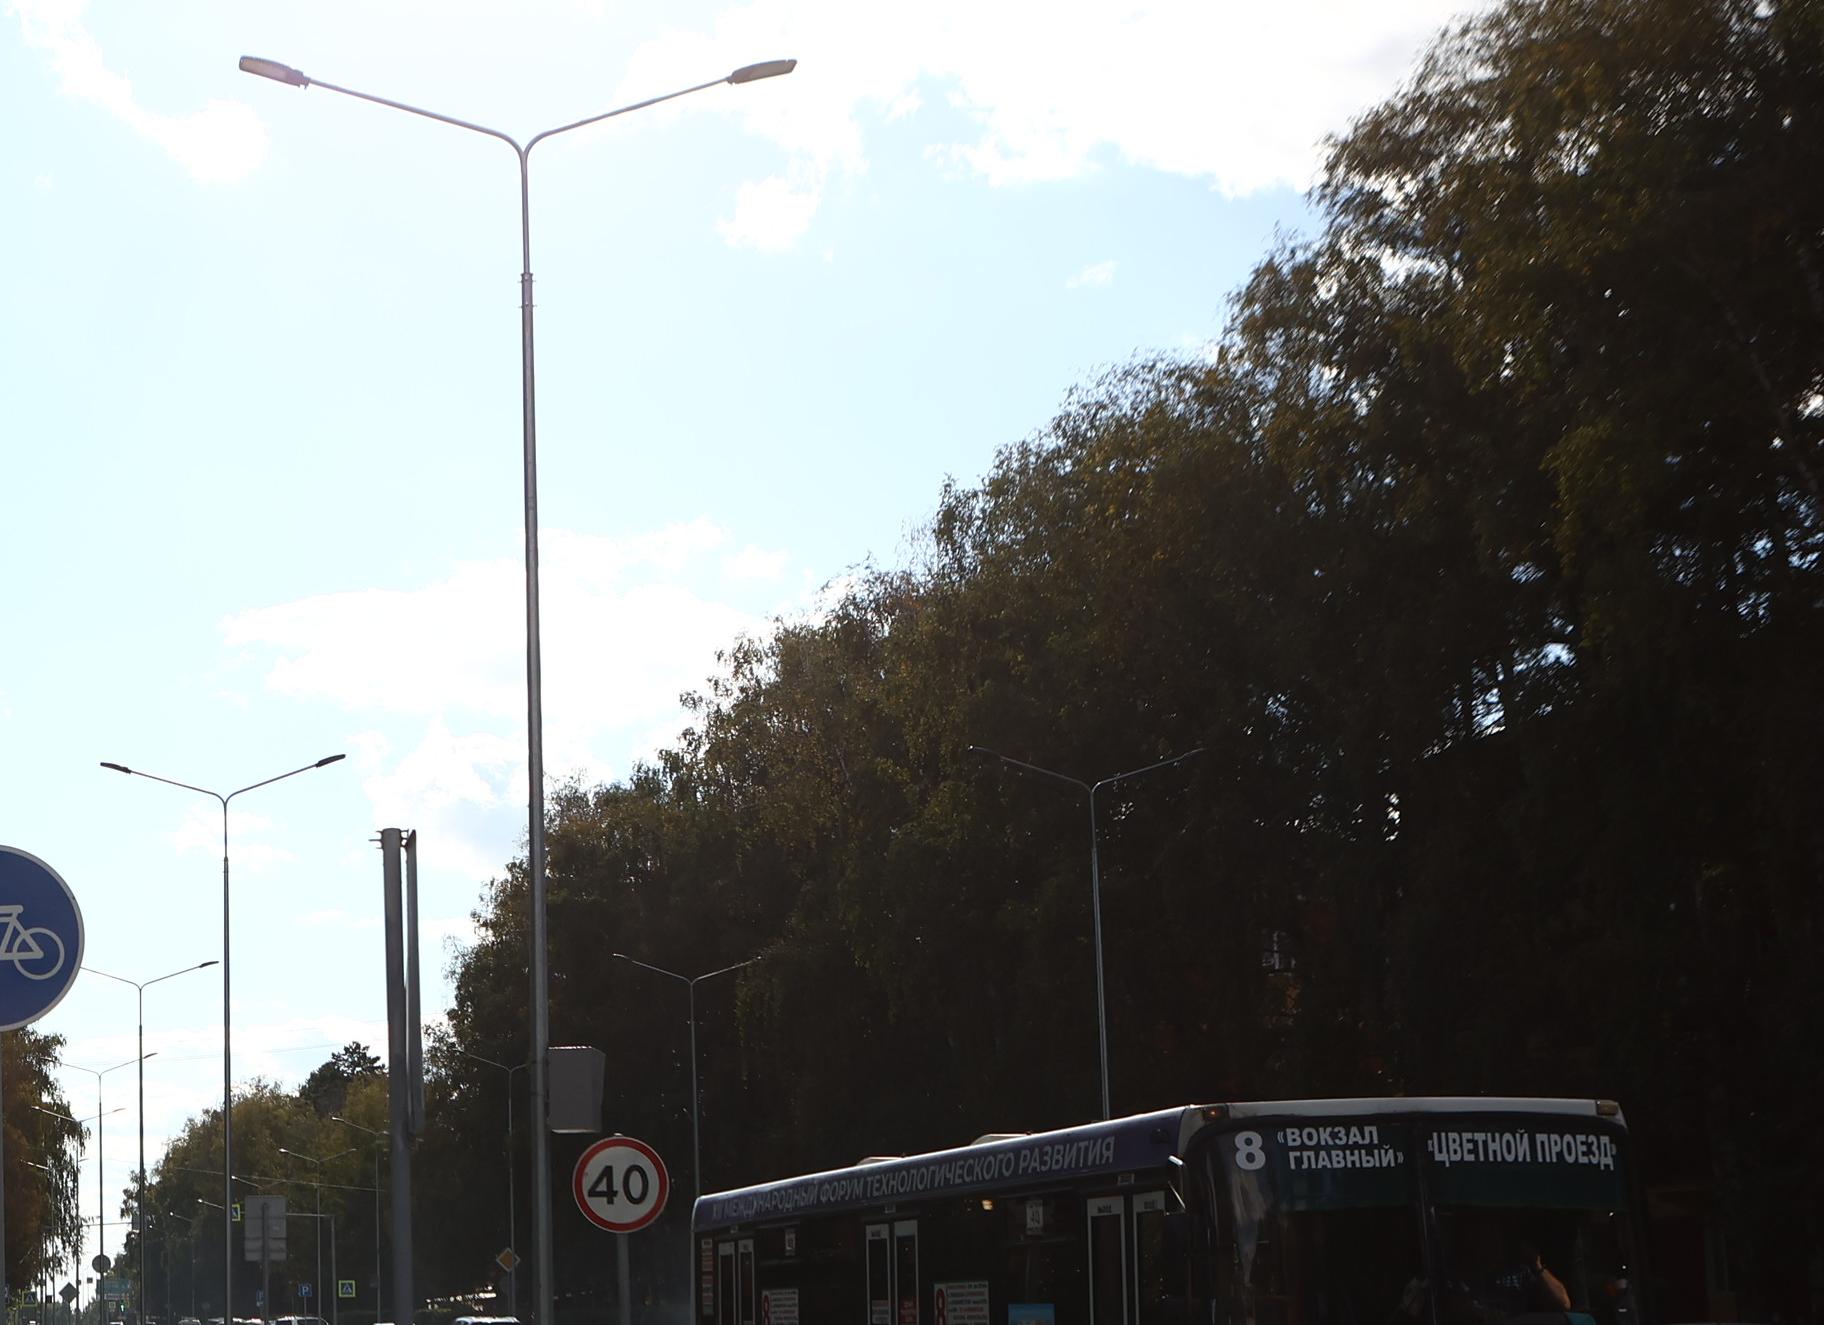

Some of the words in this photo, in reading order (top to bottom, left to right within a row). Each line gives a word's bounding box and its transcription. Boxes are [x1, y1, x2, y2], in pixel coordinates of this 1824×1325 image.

[1235, 1131, 1266, 1170] 8
[1277, 1126, 1378, 1146] «ВОКЗАЛ
[1428, 1128, 1531, 1167] «ЦВЕТНОЙ
[724, 1181, 818, 1217] МЕЖДУНАРОДНЫЙ
[820, 1177, 864, 1204] ФОРУМ
[867, 1155, 1013, 1196] ТЕХНОЛОГИЧЕСКОГО
[1020, 1136, 1114, 1174] РАЗВИТИЯ
[1289, 1145, 1404, 1169] ГЛАВНЫЙ»
[588, 1165, 649, 1205] 40
